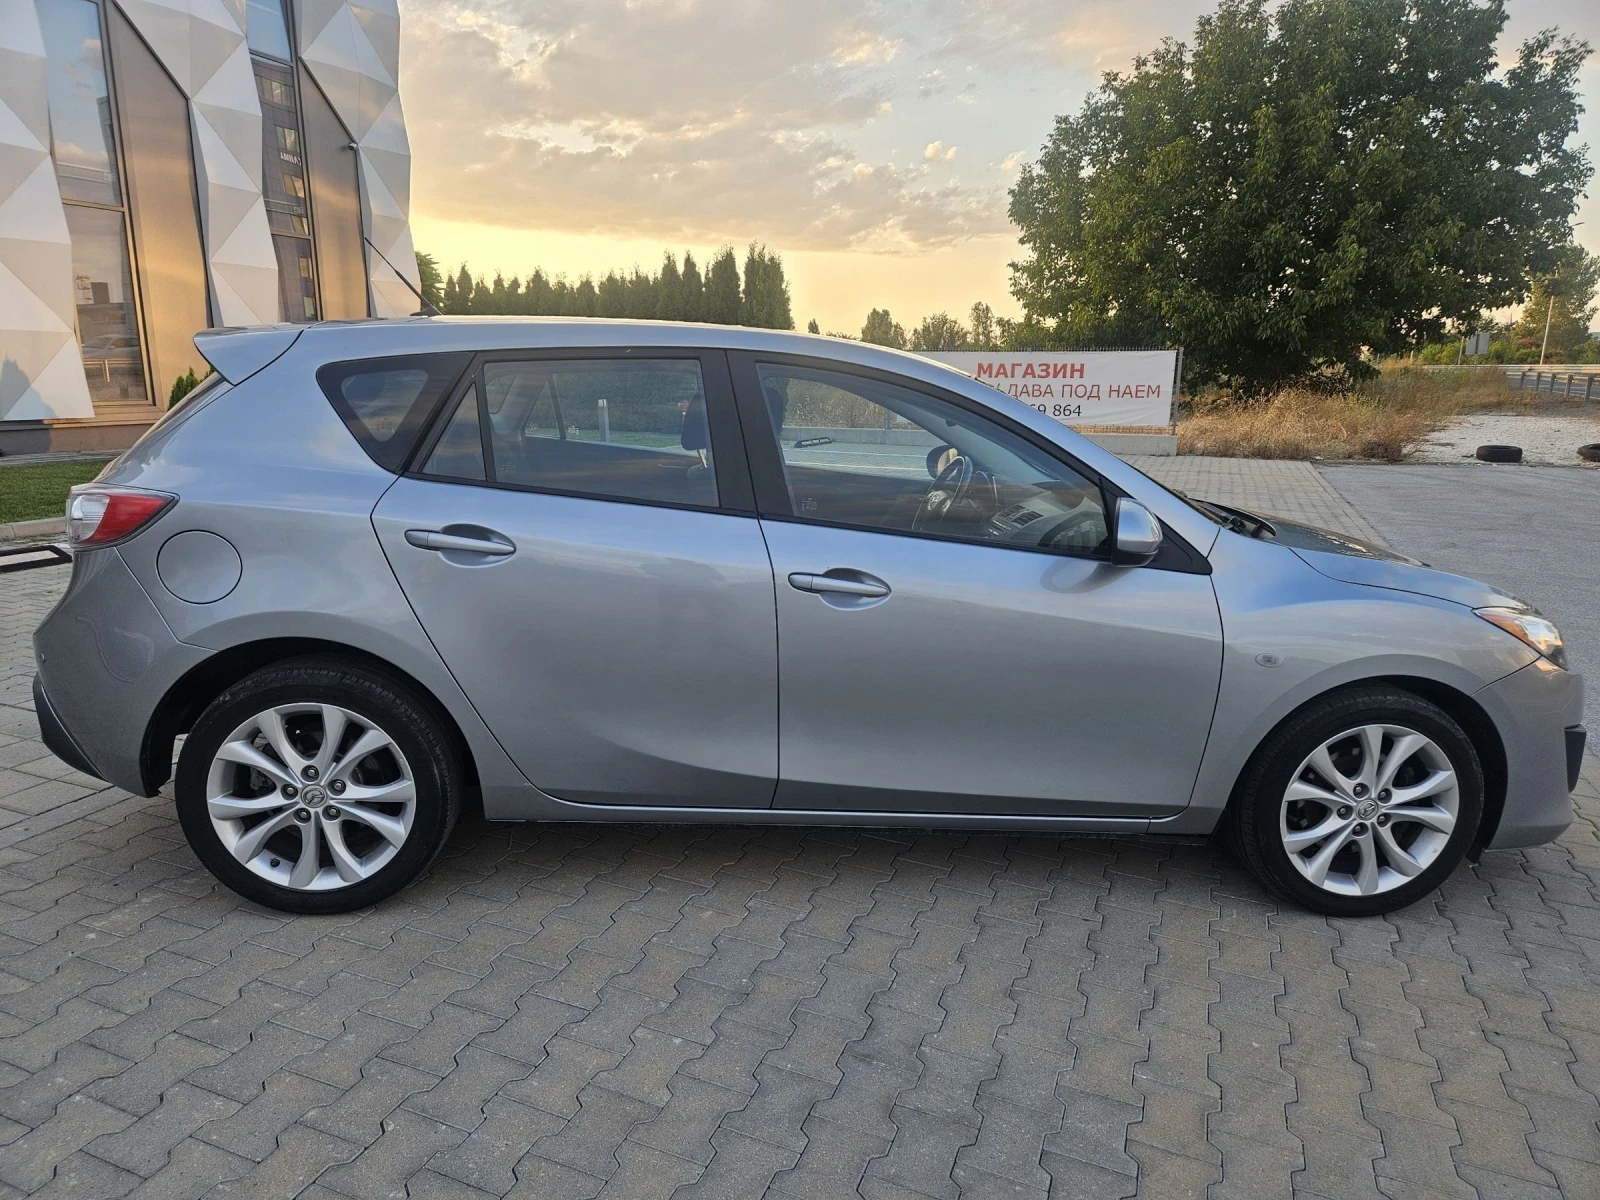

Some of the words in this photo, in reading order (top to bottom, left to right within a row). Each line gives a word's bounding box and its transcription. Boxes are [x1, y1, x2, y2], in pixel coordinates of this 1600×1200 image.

[977, 362, 1085, 379] МАГАЗИН
[1007, 383, 1054, 399] ДАВА
[1061, 384, 1101, 401] ПОД
[1108, 384, 1161, 399] НАЕМ
[1052, 403, 1082, 417] 864
